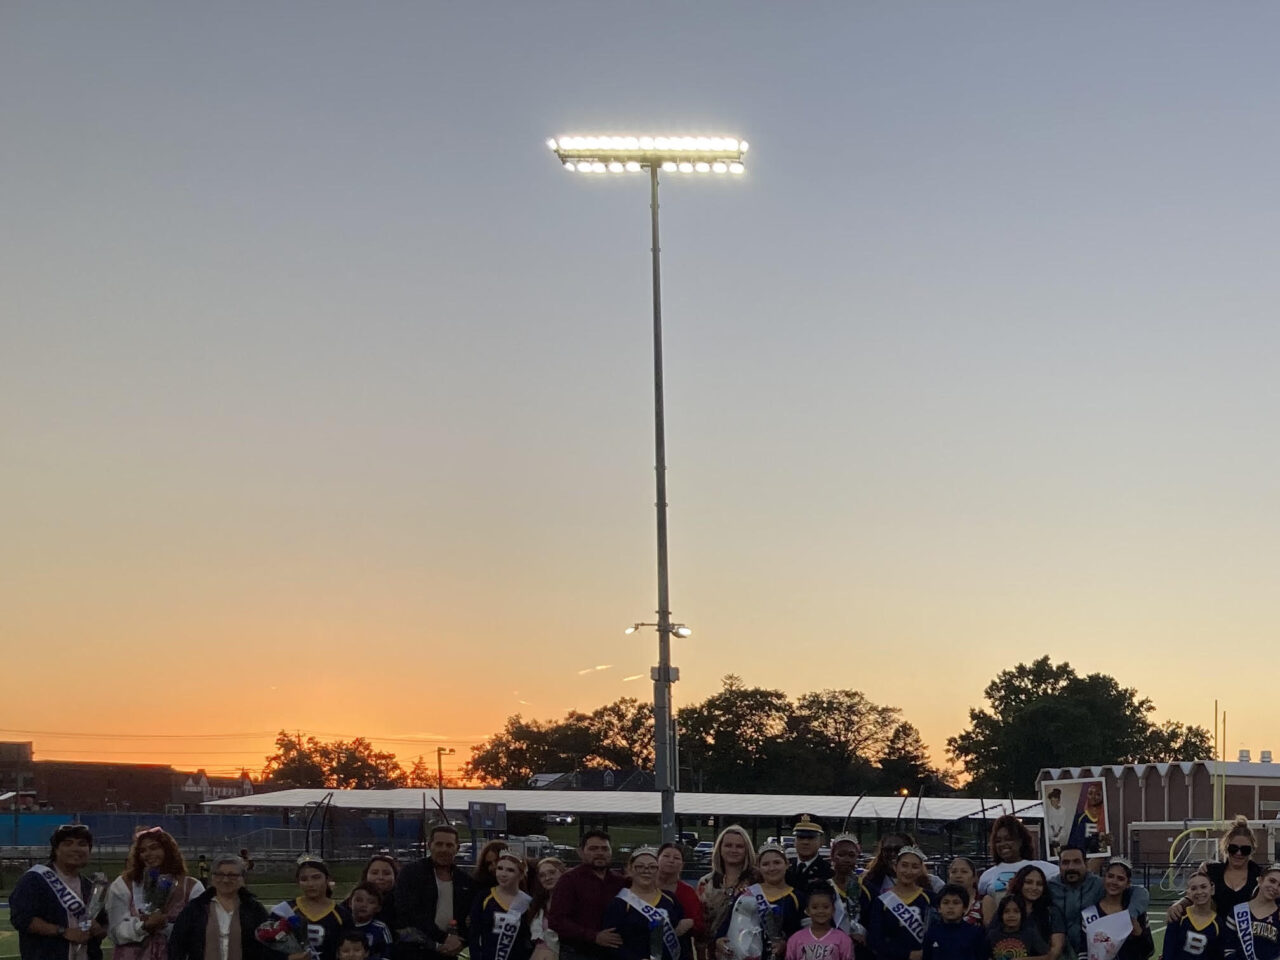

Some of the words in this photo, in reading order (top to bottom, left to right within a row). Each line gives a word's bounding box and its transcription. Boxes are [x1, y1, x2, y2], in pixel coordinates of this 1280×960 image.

[43, 870, 86, 919] SENIOR
[892, 903, 924, 939] SENIO
[1184, 930, 1209, 955] B
